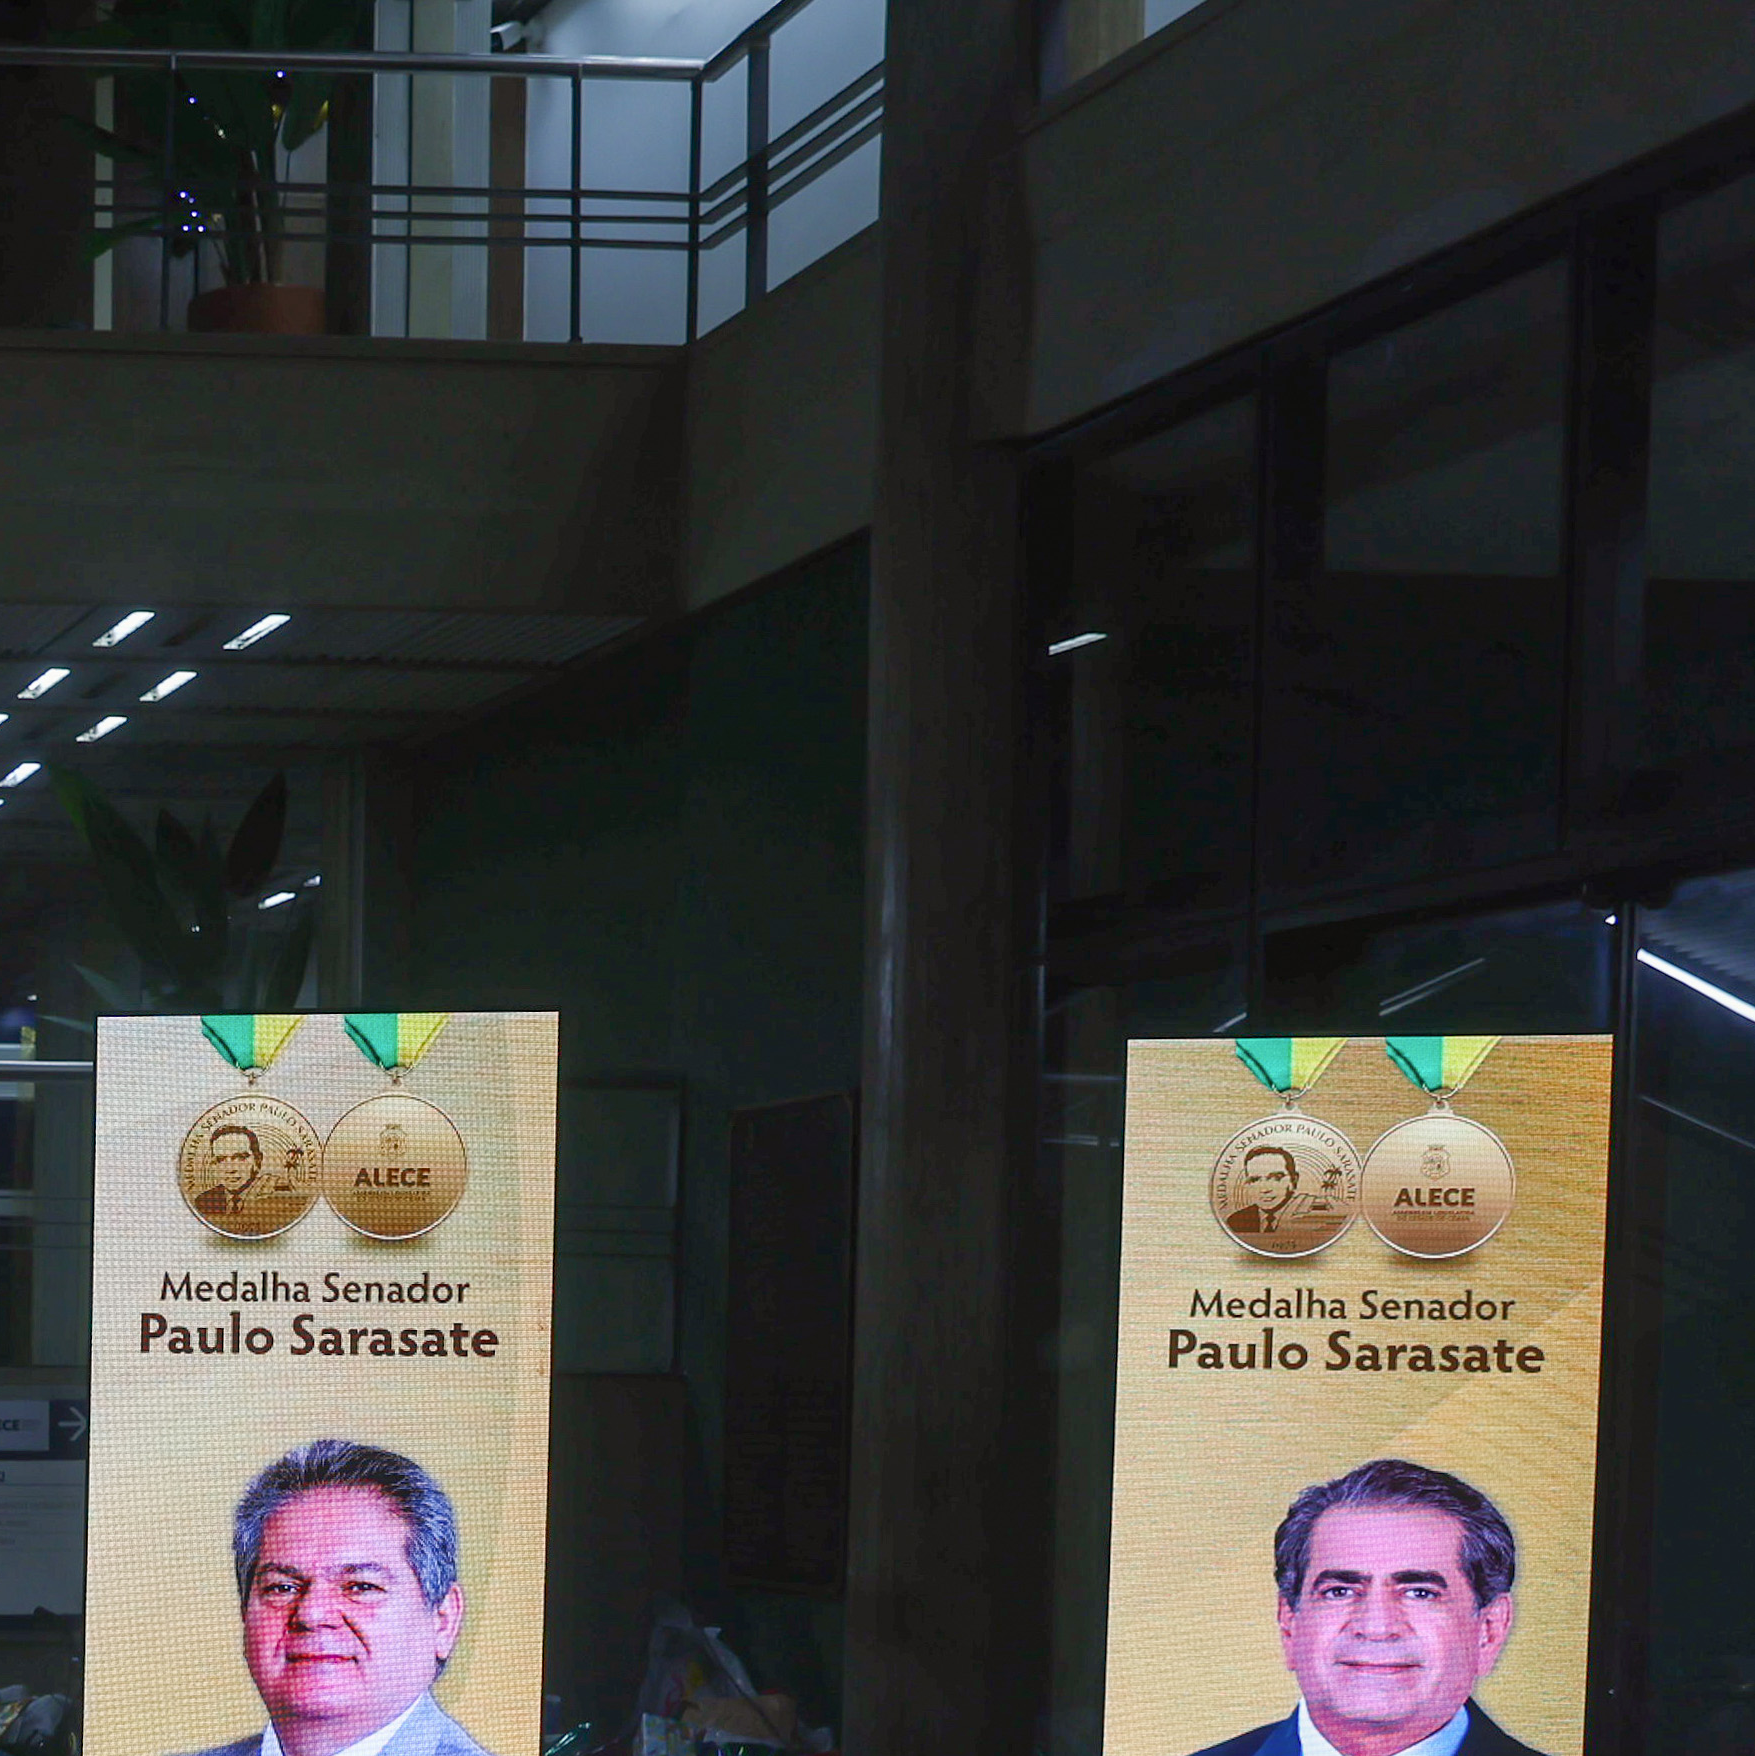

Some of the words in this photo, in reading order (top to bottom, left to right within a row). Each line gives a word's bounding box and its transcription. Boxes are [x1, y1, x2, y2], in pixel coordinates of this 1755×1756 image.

[1296, 1124, 1336, 1148] PAULO
[353, 1168, 431, 1188] ALECE
[1393, 1188, 1475, 1207] ALECE
[160, 1271, 310, 1303] Medalha
[321, 1272, 470, 1304] Senador
[1190, 1288, 1346, 1319] Medalha
[1359, 1290, 1516, 1320] Senador
[139, 1311, 274, 1355] Paulo
[290, 1313, 500, 1358] Sarasate
[1168, 1327, 1309, 1369] Paulo
[1325, 1330, 1546, 1374] Sarasate
